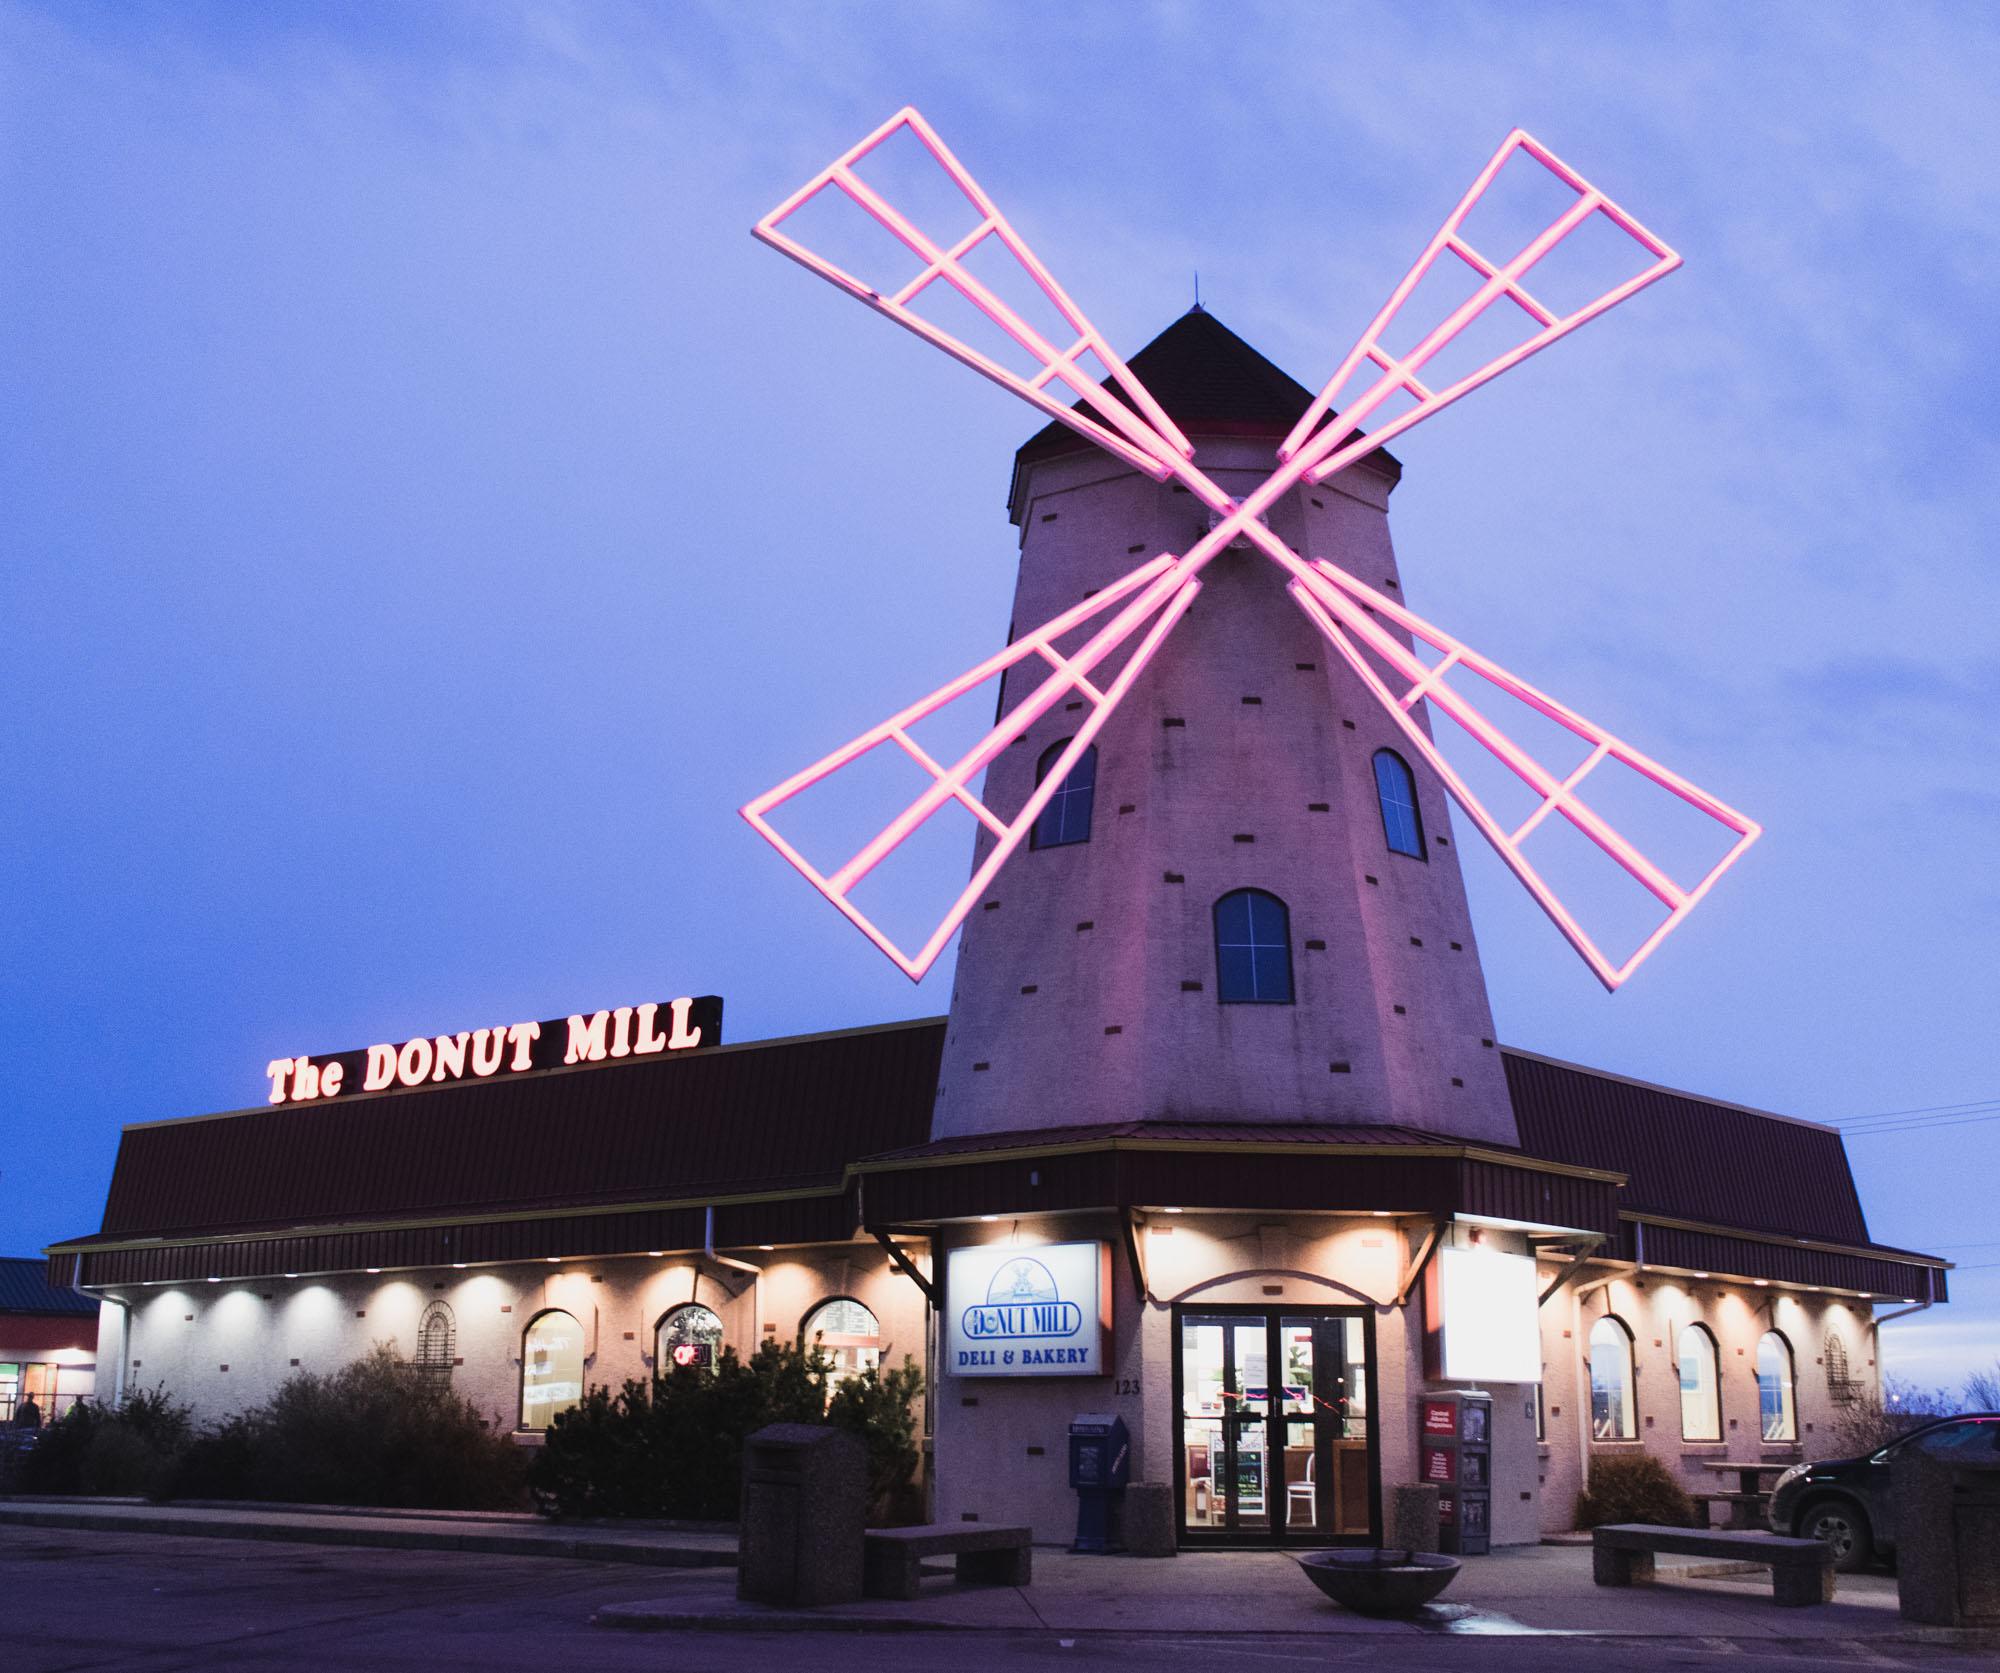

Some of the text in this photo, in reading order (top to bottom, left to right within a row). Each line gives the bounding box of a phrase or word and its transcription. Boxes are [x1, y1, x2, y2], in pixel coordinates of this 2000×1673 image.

[267, 997, 702, 1104] The DONUT MILL
[1033, 1305, 1072, 1333] MILL
[958, 1347, 1089, 1366] DELI & BAKERY
[1114, 1379, 1140, 1396] 123
